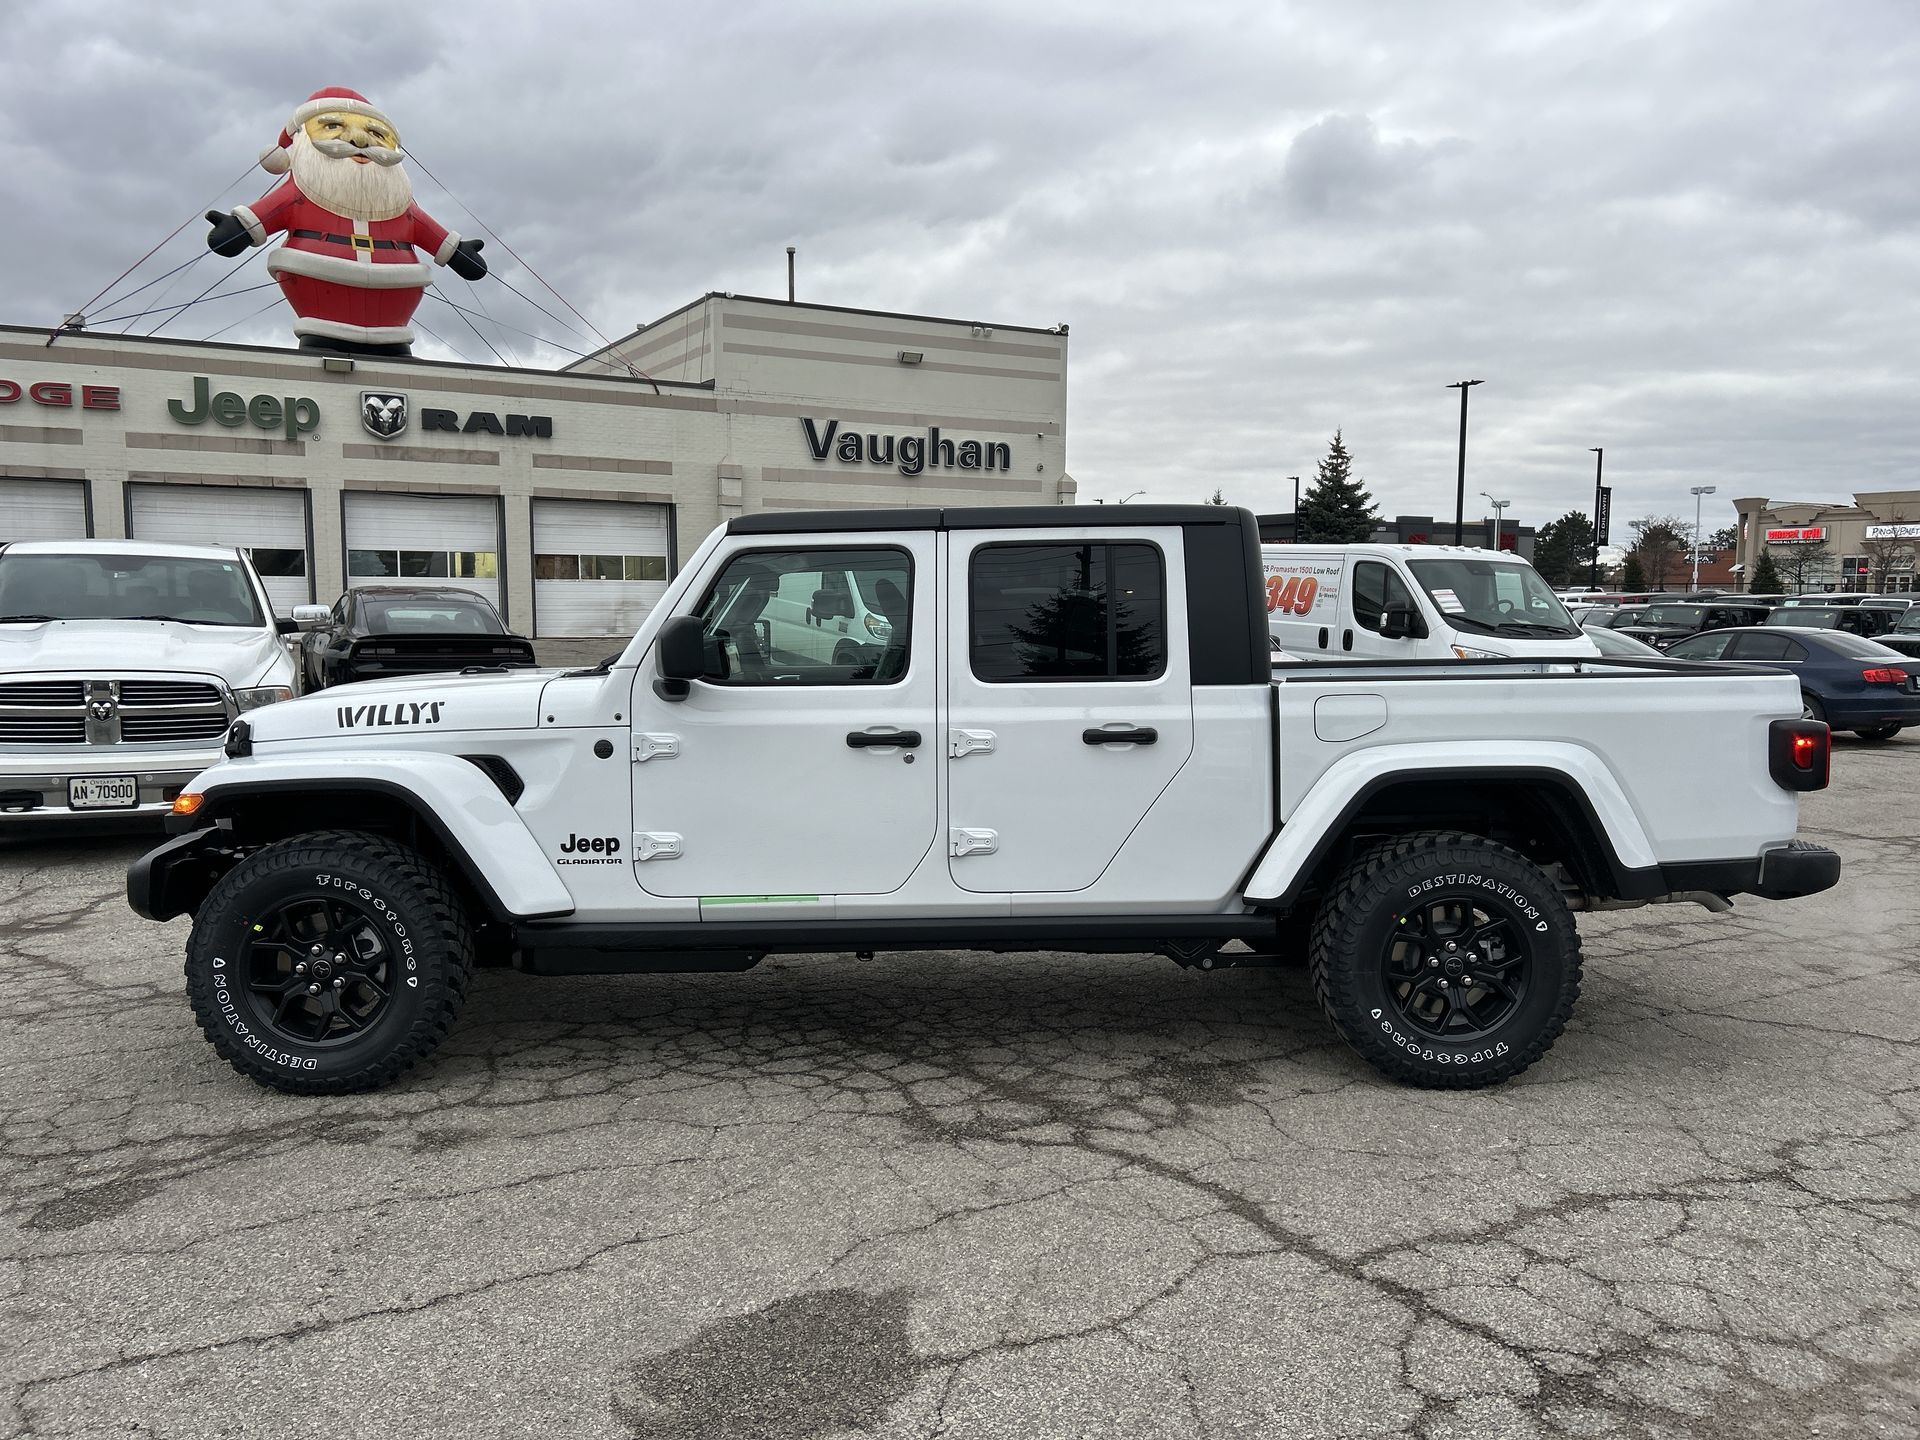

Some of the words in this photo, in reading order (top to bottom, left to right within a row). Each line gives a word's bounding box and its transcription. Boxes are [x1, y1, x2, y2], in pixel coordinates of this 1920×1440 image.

[167, 376, 321, 441] Jeep
[421, 408, 553, 438] RAM
[800, 417, 1010, 476] Vaughan
[1270, 565, 1298, 574] Promaster
[1299, 566, 1313, 574] 1500
[1313, 567, 1325, 575] Low
[1326, 567, 1340, 576] Roof
[1264, 575, 1319, 618] 349
[337, 701, 445, 728] WILLYS
[95, 785, 133, 799] 70900
[560, 833, 620, 856] Jeep
[1408, 873, 1539, 919] DESTINATION
[213, 973, 318, 1070] DESTINATION
